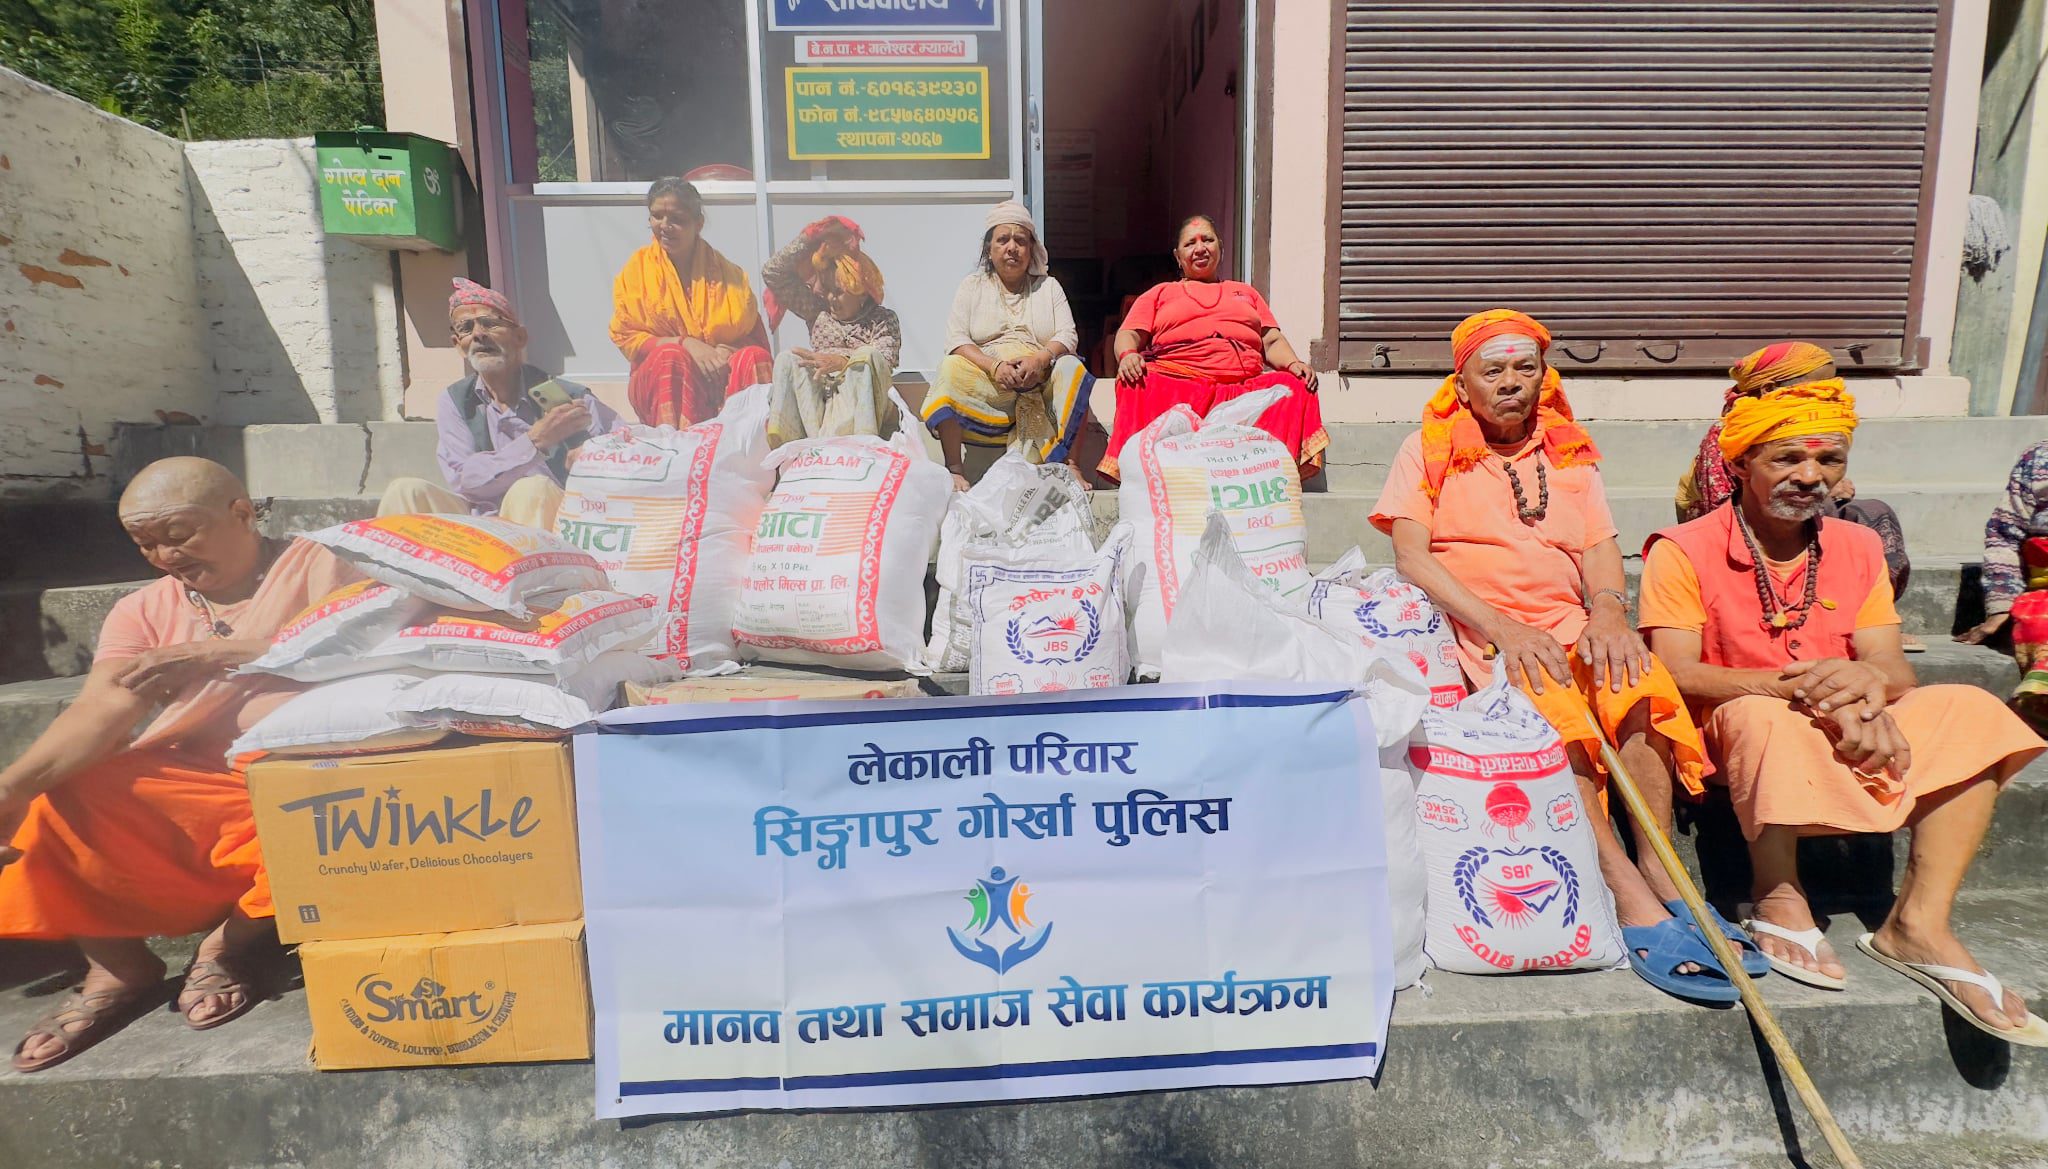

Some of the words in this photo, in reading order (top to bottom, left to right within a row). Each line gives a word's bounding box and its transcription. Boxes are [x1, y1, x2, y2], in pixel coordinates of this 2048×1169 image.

[795, 81, 832, 96] पान
[798, 105, 838, 123] फोन
[370, 168, 406, 192] दान
[342, 189, 398, 217] पेटिका
[791, 456, 861, 468] NGALAM
[1211, 476, 1290, 511] आटा
[558, 518, 636, 552] आटा
[757, 512, 828, 538] आटा
[1251, 553, 1304, 577] MANGA
[1397, 610, 1421, 622] JBS
[420, 622, 469, 636] मंगलम
[1044, 641, 1069, 652] JBS
[848, 735, 995, 786] लेकाली
[1008, 731, 1138, 777] परिवार
[753, 804, 942, 870] सिङ्गापुर
[957, 792, 1075, 841] गोर्खा
[1092, 789, 1233, 848] पुलिस
[318, 862, 369, 877] Crunchy
[410, 854, 461, 870] Delicious
[463, 851, 534, 866] Chocolayers
[1501, 864, 1534, 881] JBS
[364, 980, 487, 1023] Smart
[663, 1007, 782, 1048] मानव
[796, 1001, 887, 1045] तथा
[901, 988, 1033, 1038] समाज
[1046, 975, 1129, 1024] सेवा
[1141, 970, 1331, 1016] कार्यक्रम
